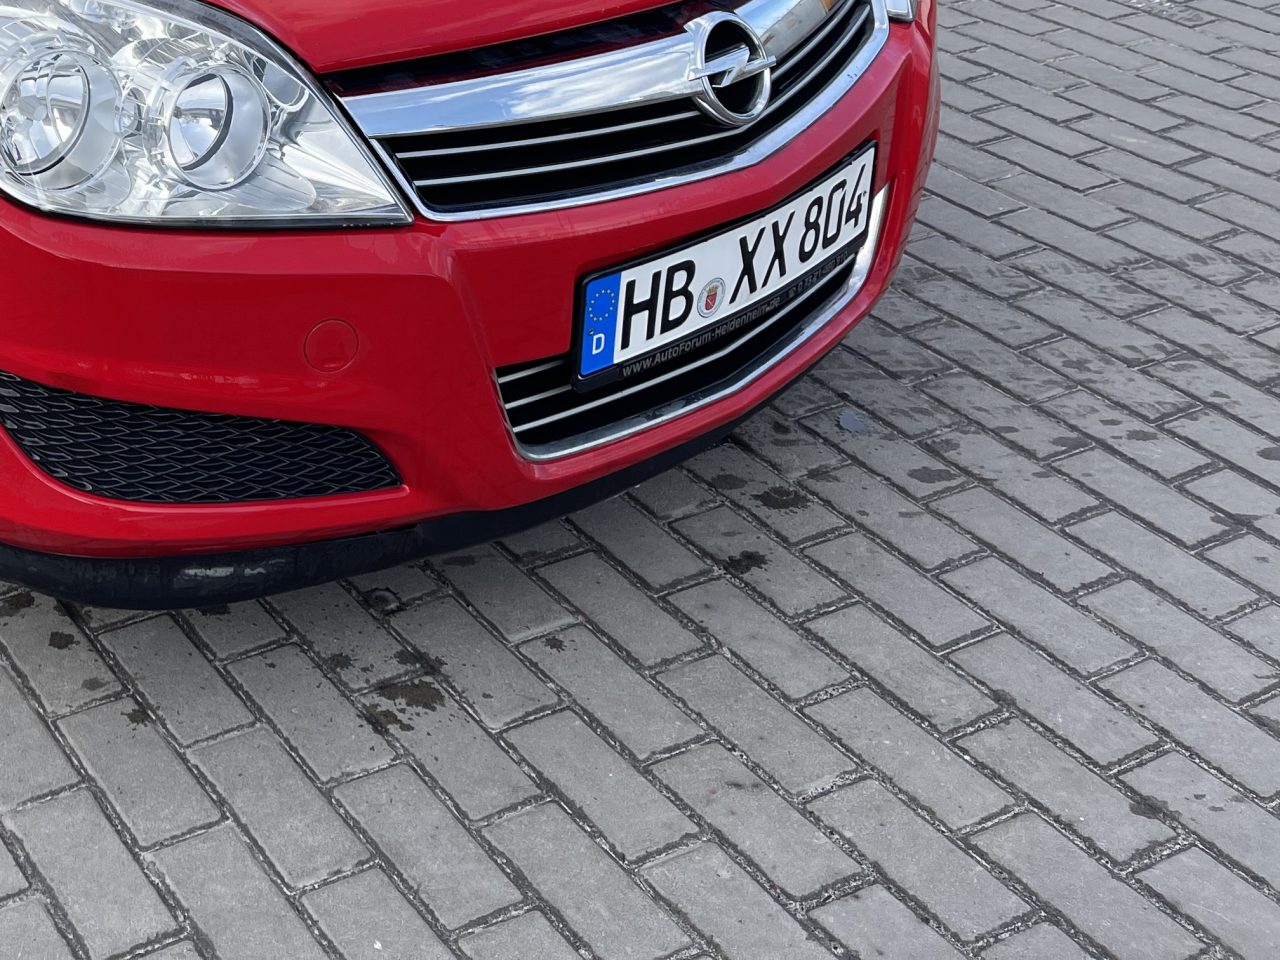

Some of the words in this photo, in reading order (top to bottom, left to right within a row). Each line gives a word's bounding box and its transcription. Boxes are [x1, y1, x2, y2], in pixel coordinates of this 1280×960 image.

[620, 259, 696, 352] HB
[728, 210, 796, 305] XX
[798, 163, 866, 263] 804
[591, 332, 606, 355] D
